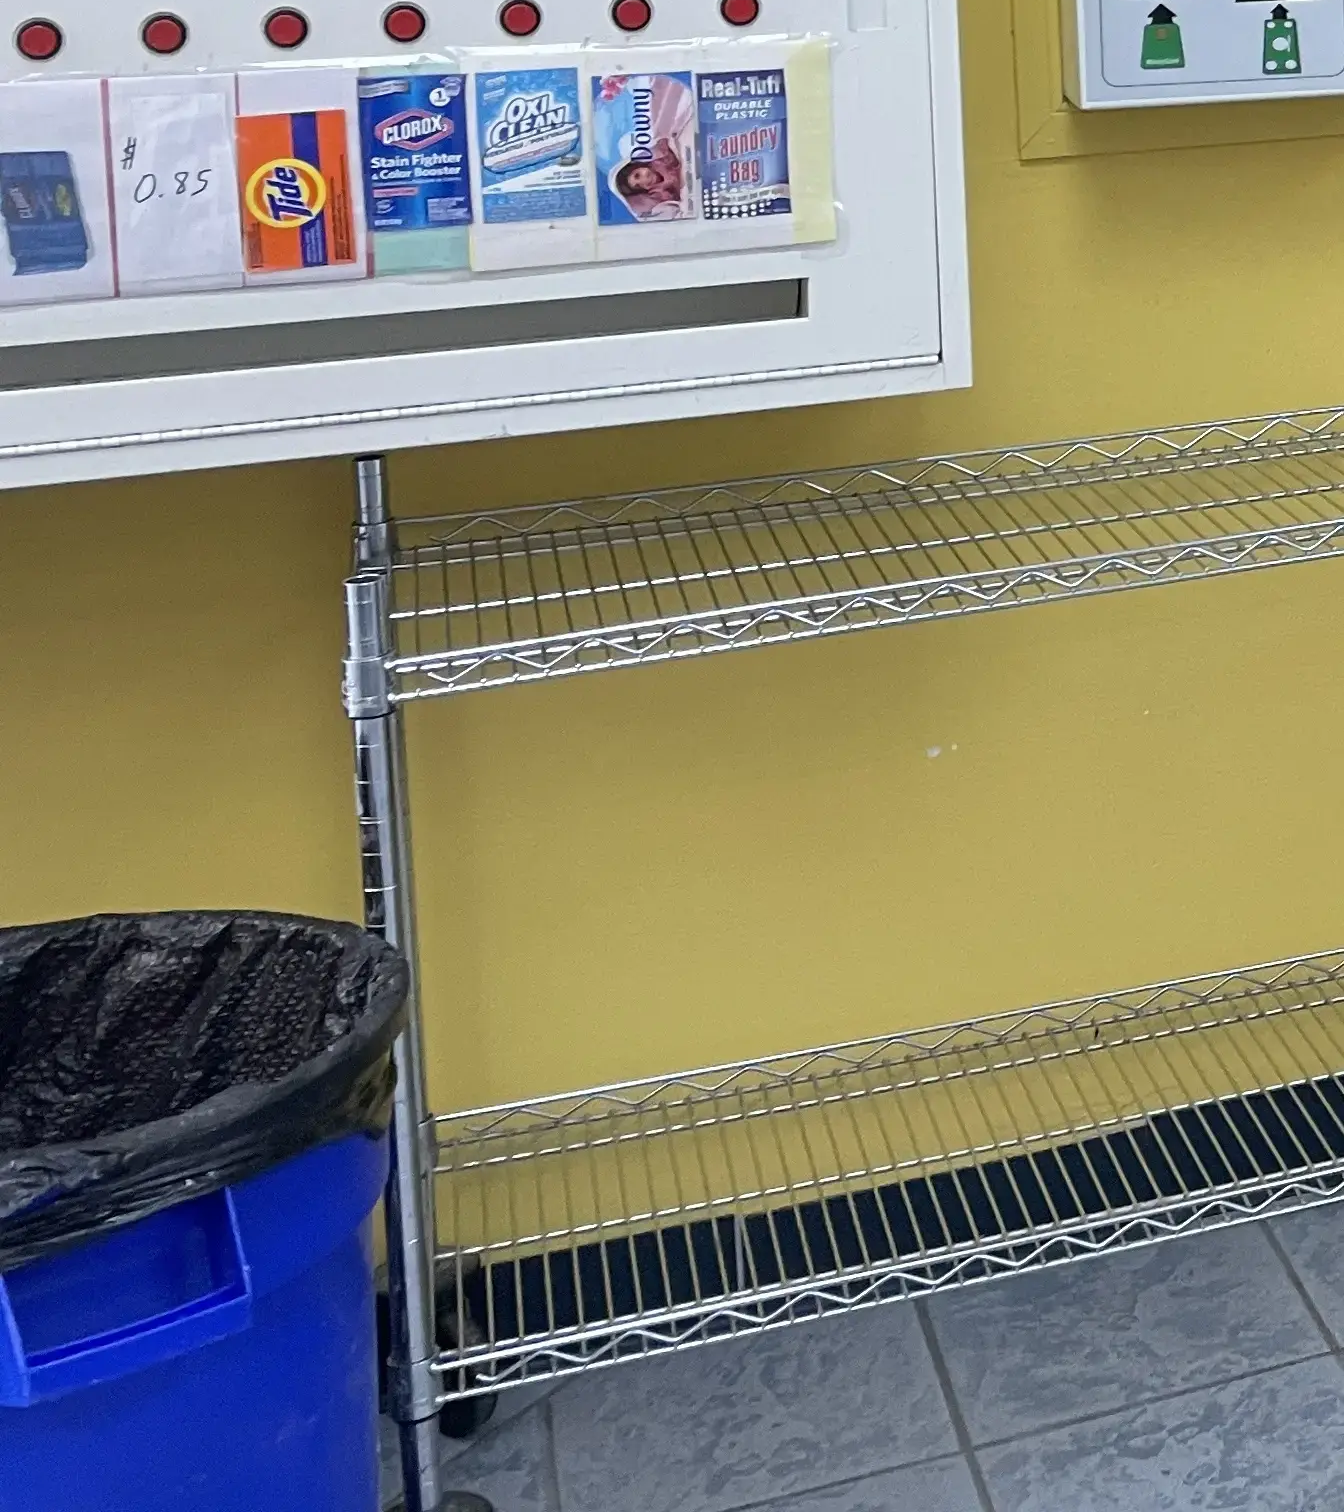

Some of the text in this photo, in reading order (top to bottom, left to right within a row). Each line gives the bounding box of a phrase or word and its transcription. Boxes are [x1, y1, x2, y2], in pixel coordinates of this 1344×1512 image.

[506, 94, 549, 123] OXI
[714, 100, 772, 111] DURABLE
[716, 110, 767, 120] PLASTIC
[491, 106, 566, 147] CLEAN
[708, 125, 778, 160] Laundry
[371, 154, 462, 168] Stain Fighter
[379, 169, 412, 179] Color
[414, 167, 461, 177] Booster
[730, 158, 760, 183] Bag
[134, 168, 212, 204] 0.85
[266, 166, 313, 221] Tide
